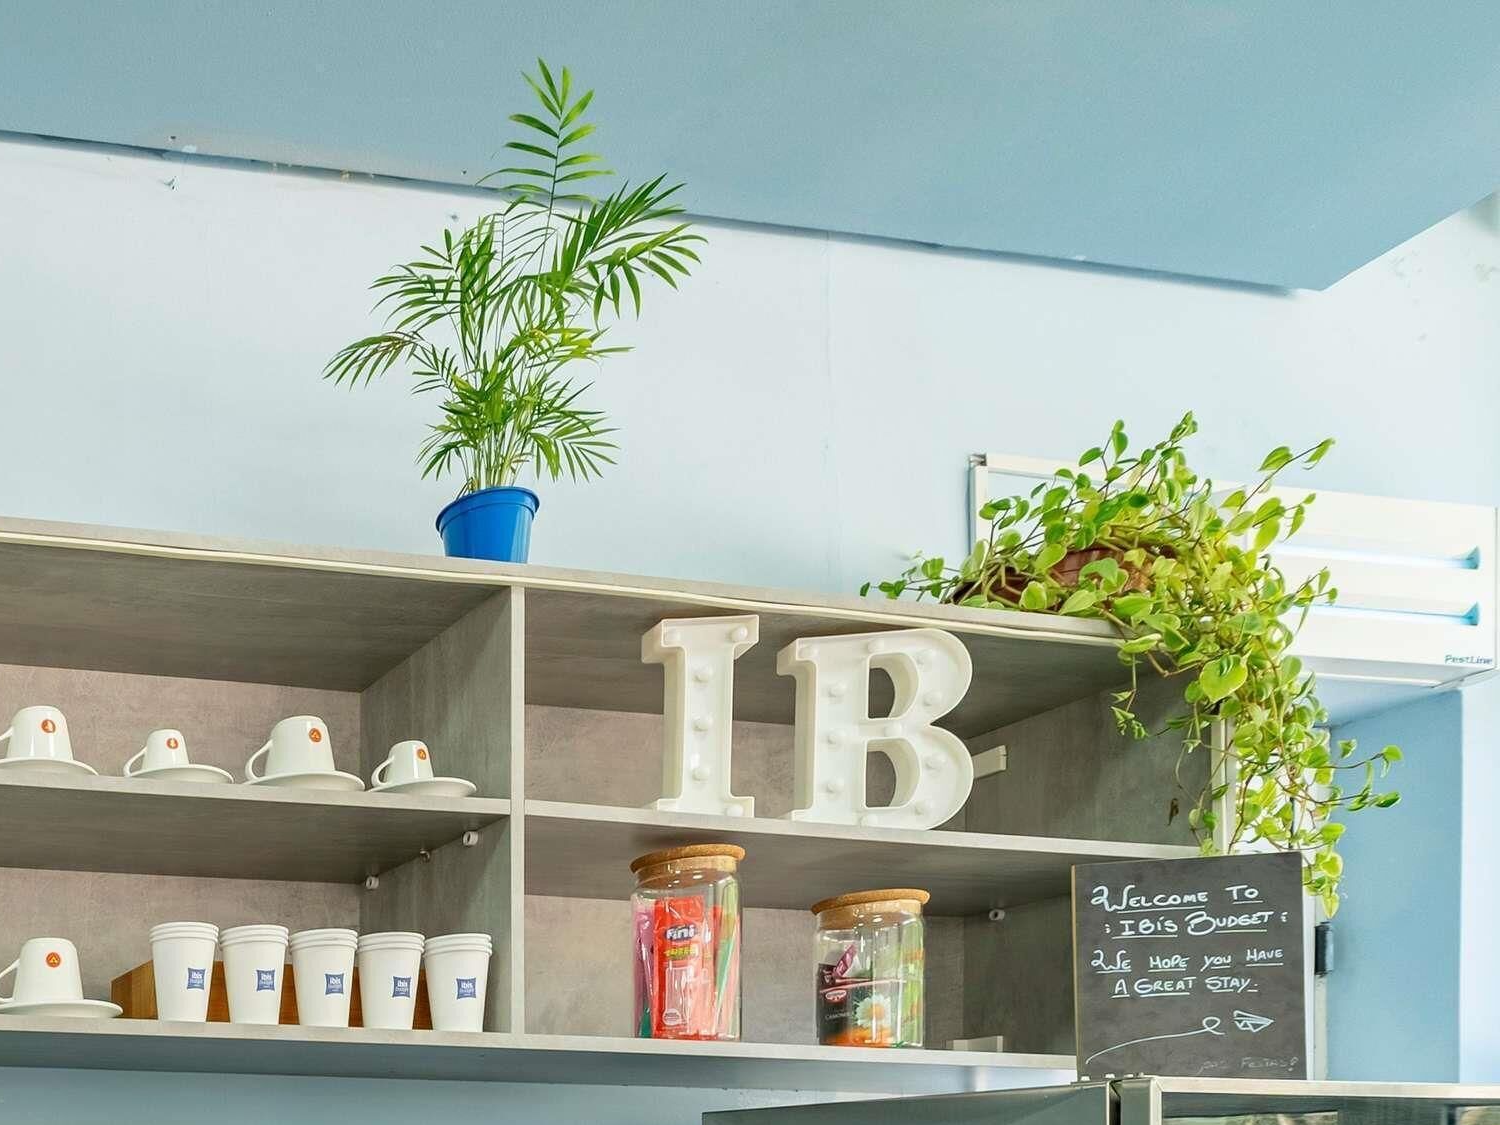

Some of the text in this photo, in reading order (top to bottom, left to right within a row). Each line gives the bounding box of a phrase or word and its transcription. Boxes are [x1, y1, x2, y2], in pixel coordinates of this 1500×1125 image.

[1225, 885, 1259, 900] TO
[1185, 911, 1274, 936] BUDGET
[1149, 956, 1190, 970] HOPE
[1246, 948, 1284, 962] HAVE
[1114, 979, 1128, 995] A
[1134, 977, 1197, 992] GREAT
